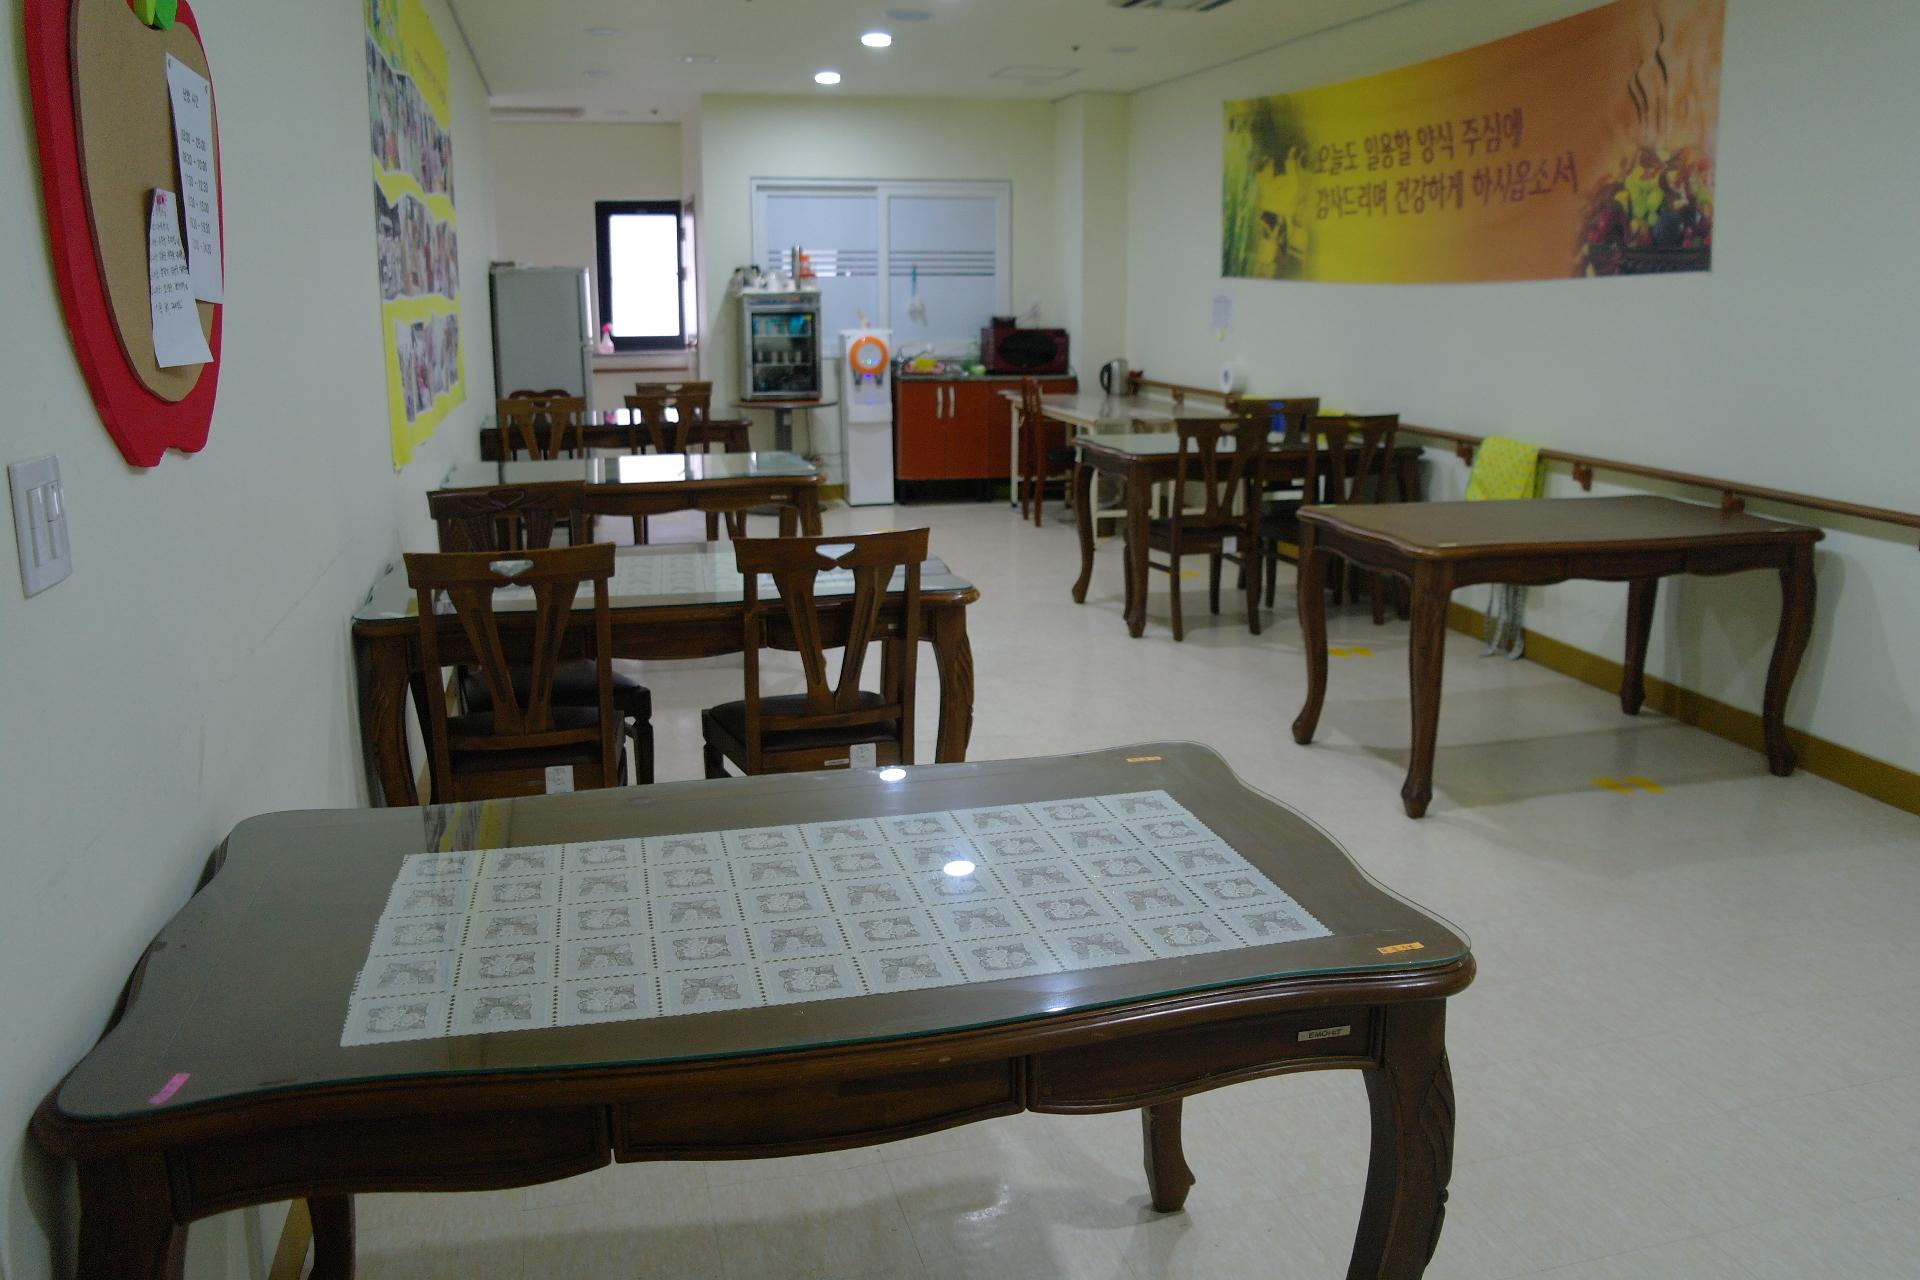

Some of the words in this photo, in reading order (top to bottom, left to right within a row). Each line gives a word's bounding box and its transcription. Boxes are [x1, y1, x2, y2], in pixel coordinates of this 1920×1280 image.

[1317, 142, 1358, 175] 오늘도
[1364, 128, 1411, 171] 일용할
[1416, 121, 1455, 164] 양식
[1462, 107, 1523, 158] 주심에
[1316, 180, 1388, 219] 감사드리며
[1395, 169, 1465, 215] 건강하게
[1471, 150, 1580, 207] 하시옵소서
